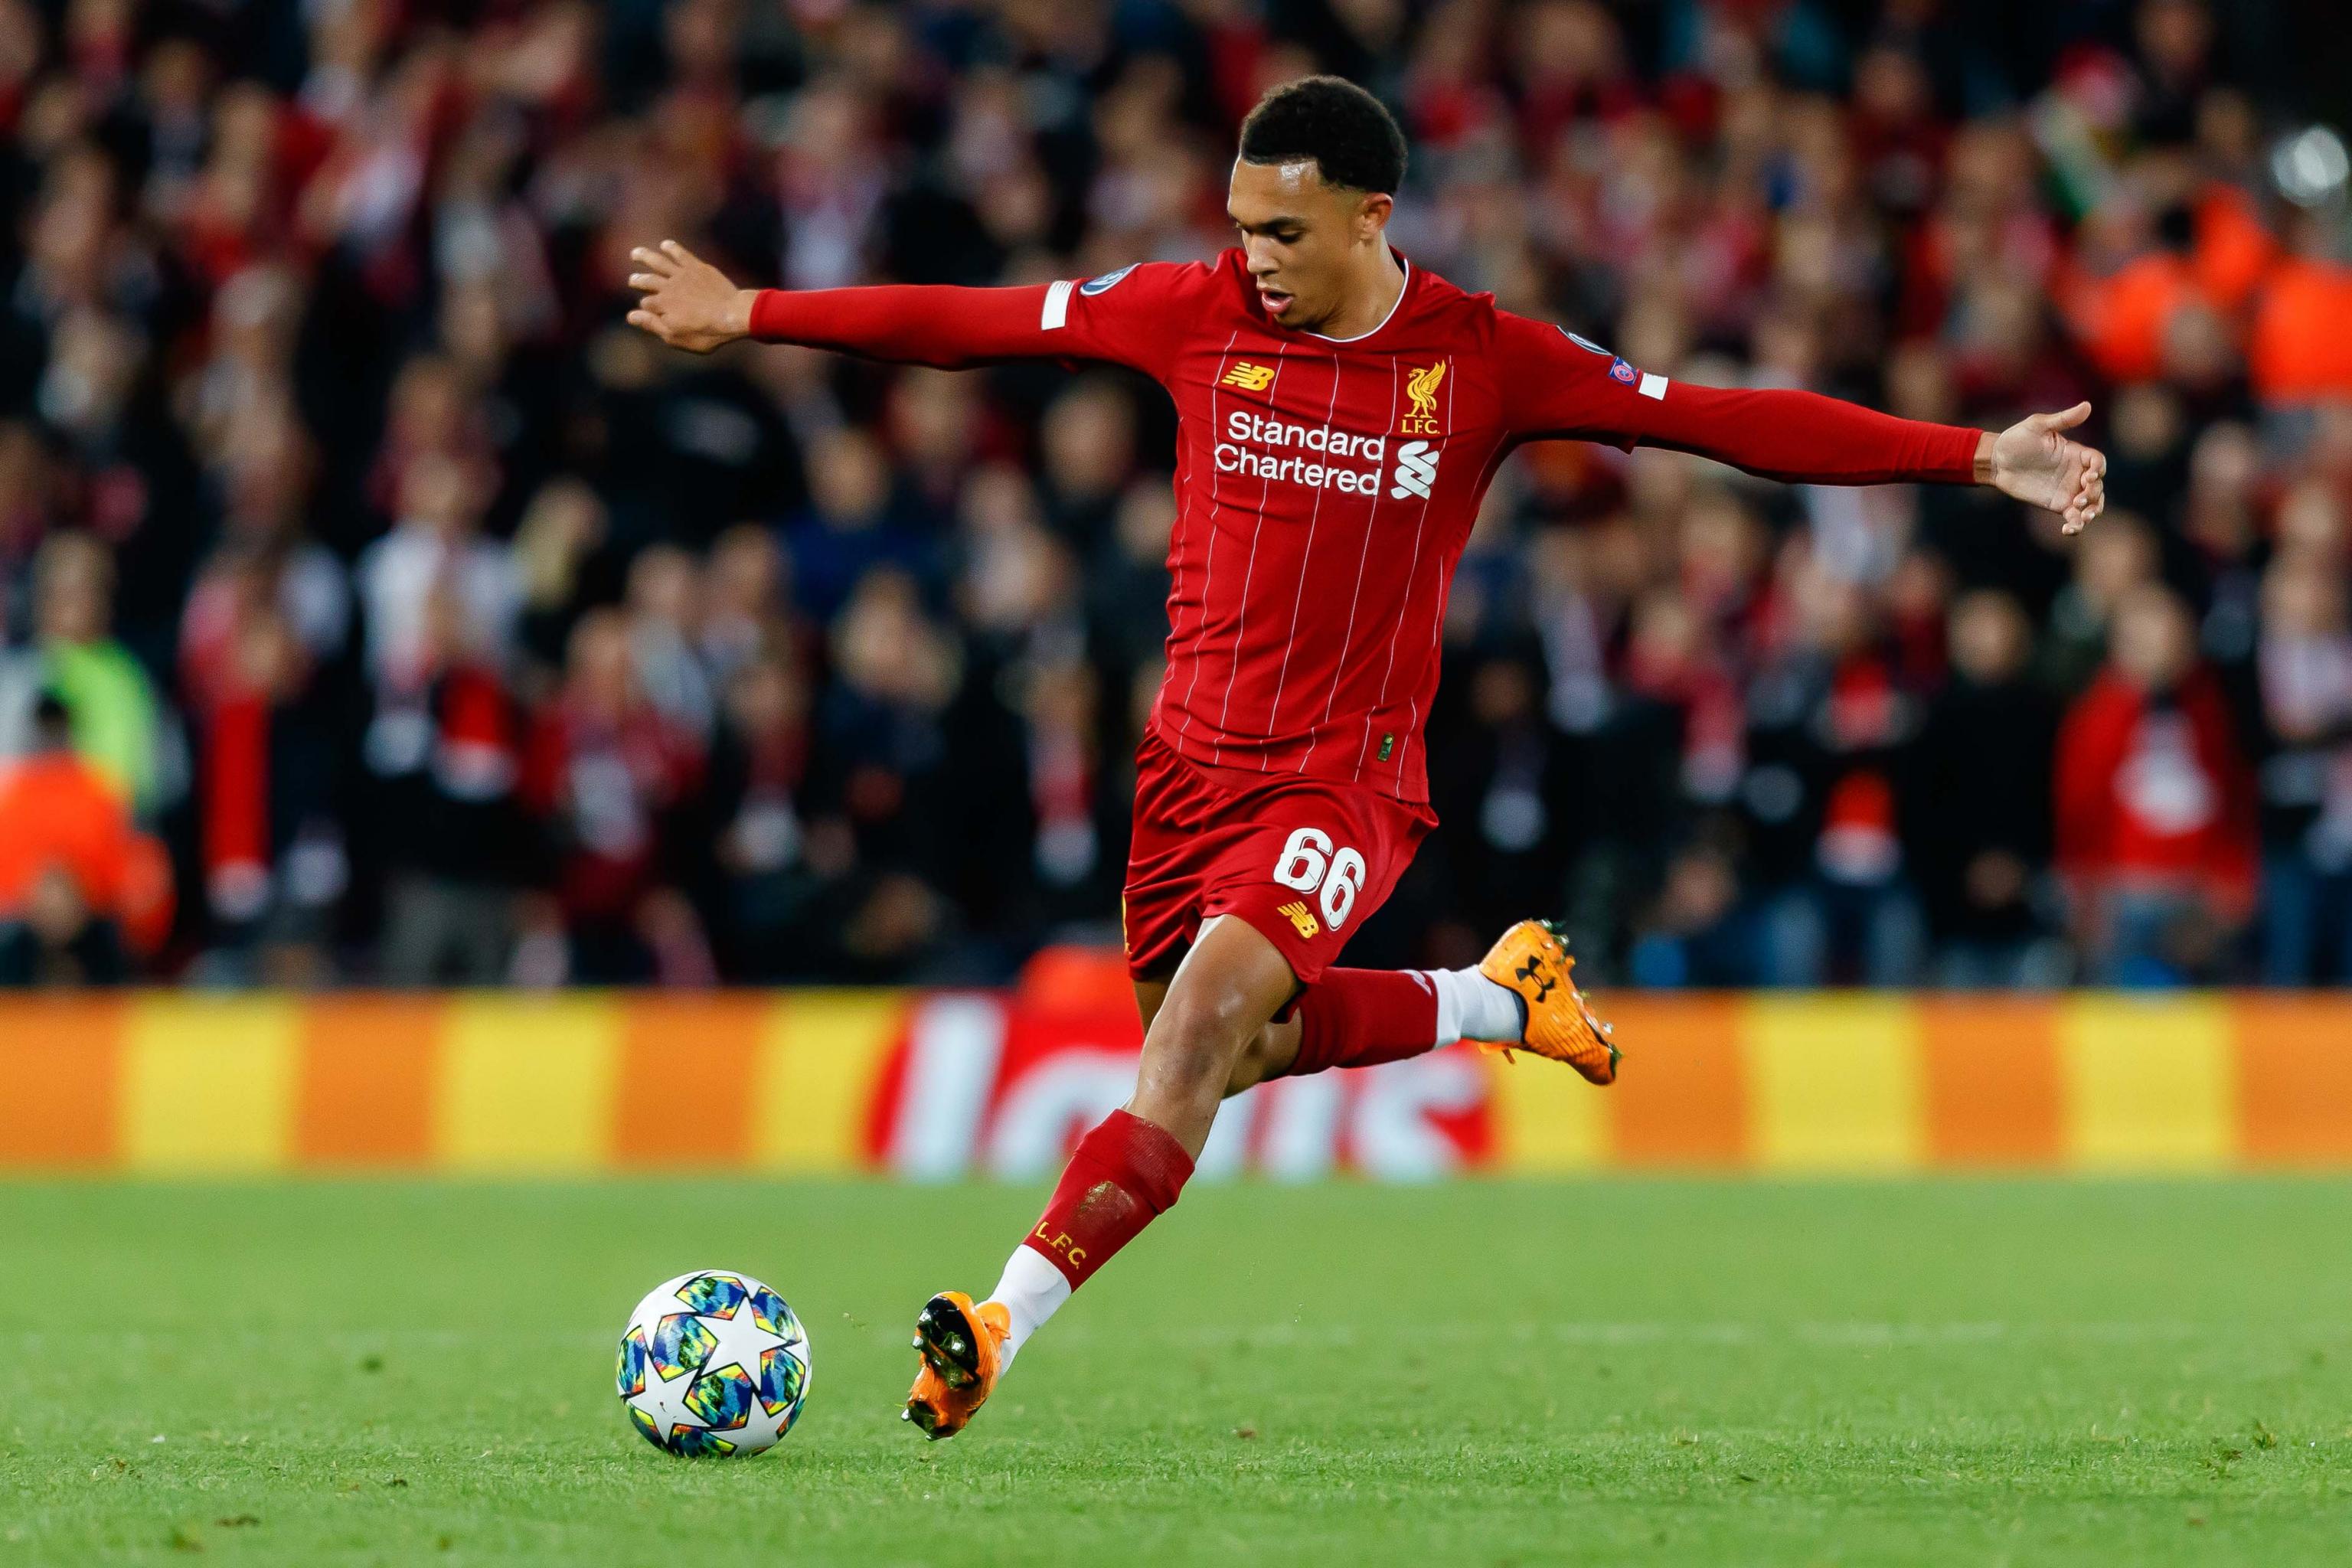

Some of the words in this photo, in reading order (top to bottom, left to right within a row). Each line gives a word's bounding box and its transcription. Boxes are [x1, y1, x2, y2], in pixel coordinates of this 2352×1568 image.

[1227, 411, 1385, 461] Standard
[1214, 443, 1381, 496] Chartered
[1272, 827, 1366, 931] 66
